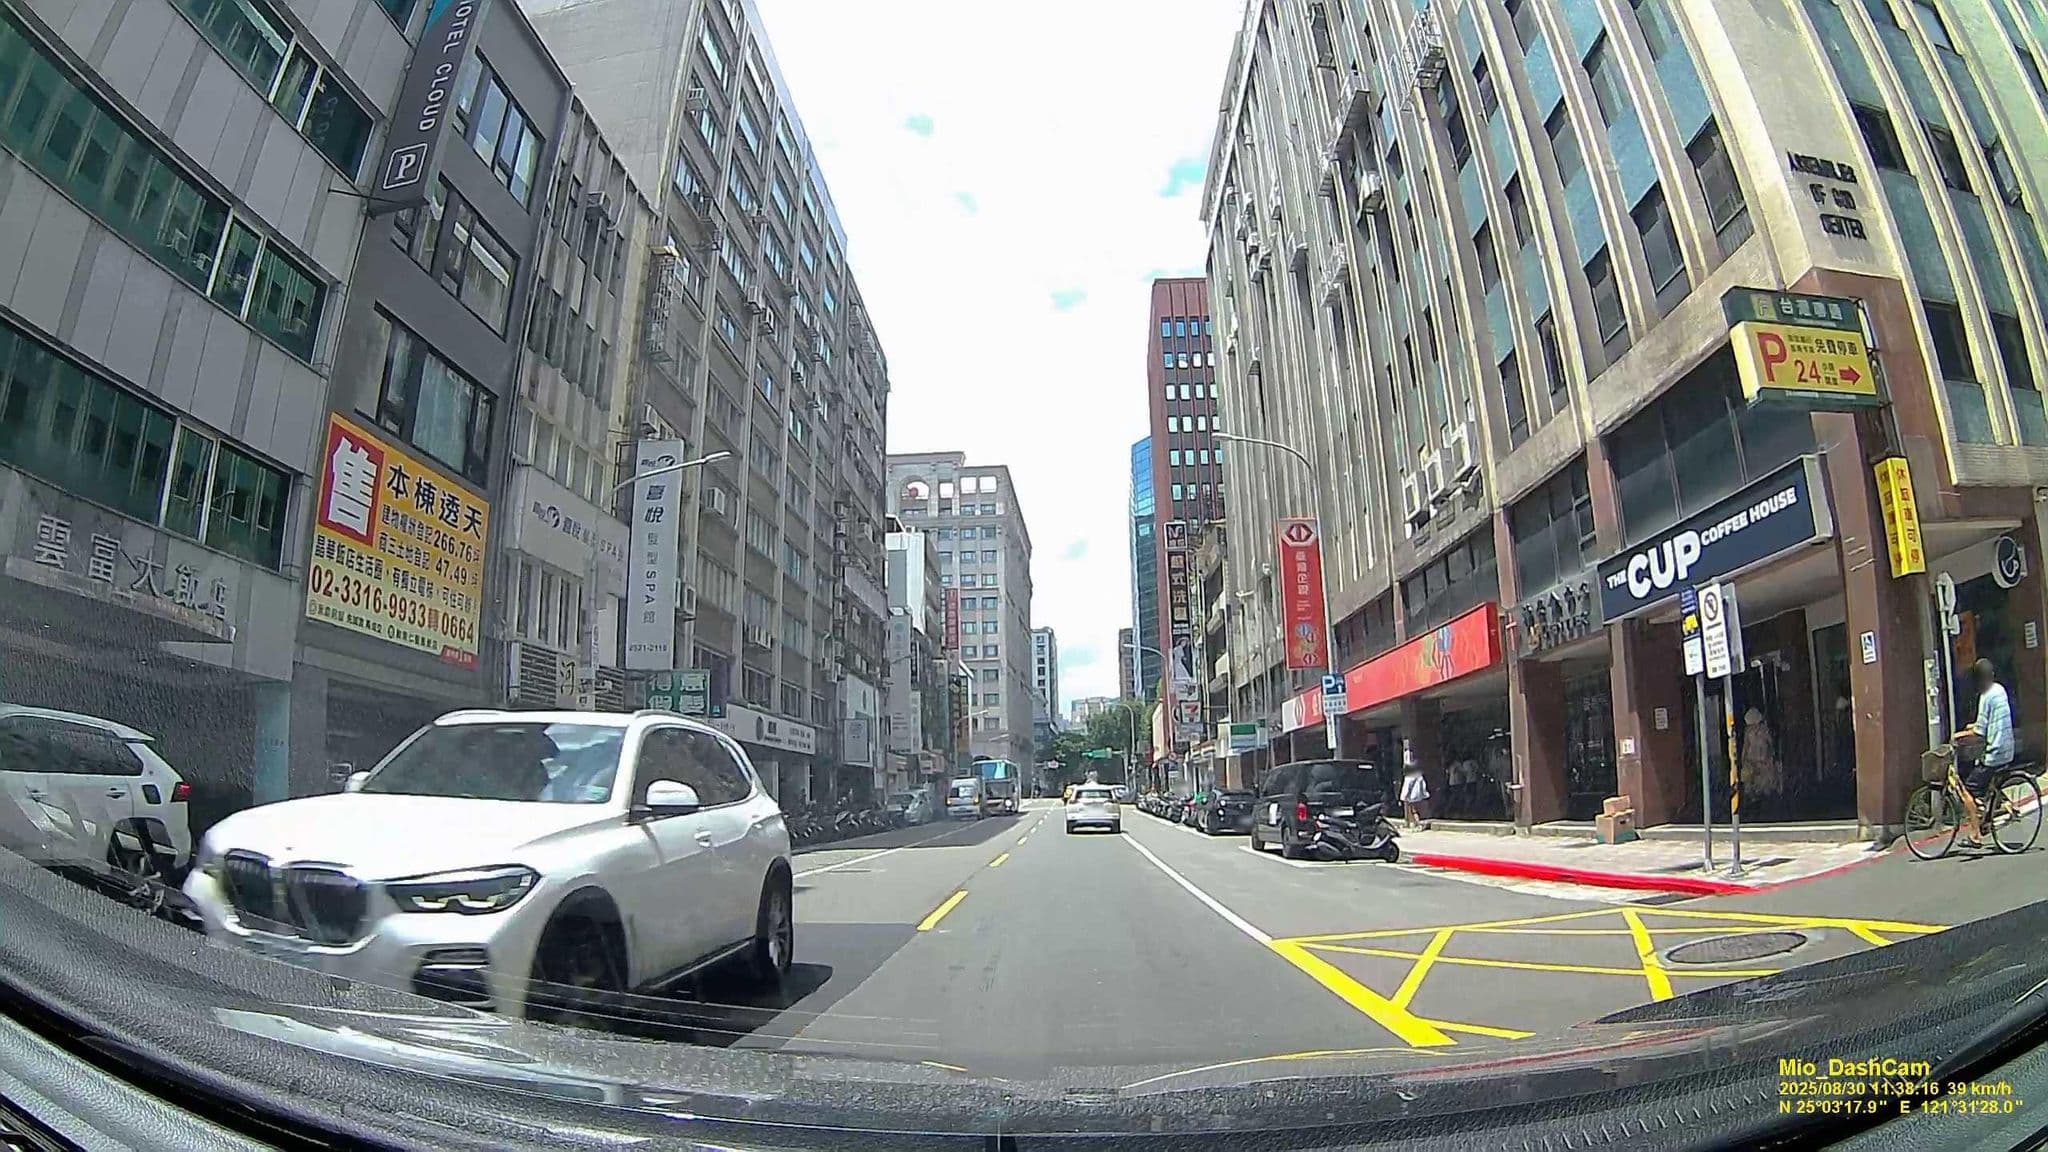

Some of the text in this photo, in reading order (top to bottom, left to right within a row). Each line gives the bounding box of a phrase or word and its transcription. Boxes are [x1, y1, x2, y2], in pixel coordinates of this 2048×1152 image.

[419, 63, 452, 131] CLOUD
[395, 154, 416, 180] P
[1756, 332, 1787, 382] P
[1794, 359, 1821, 384] 24
[328, 437, 378, 537] 售
[387, 463, 483, 540] 本棟透天
[1606, 486, 1798, 599] THE CUP COFFEE HOUSE
